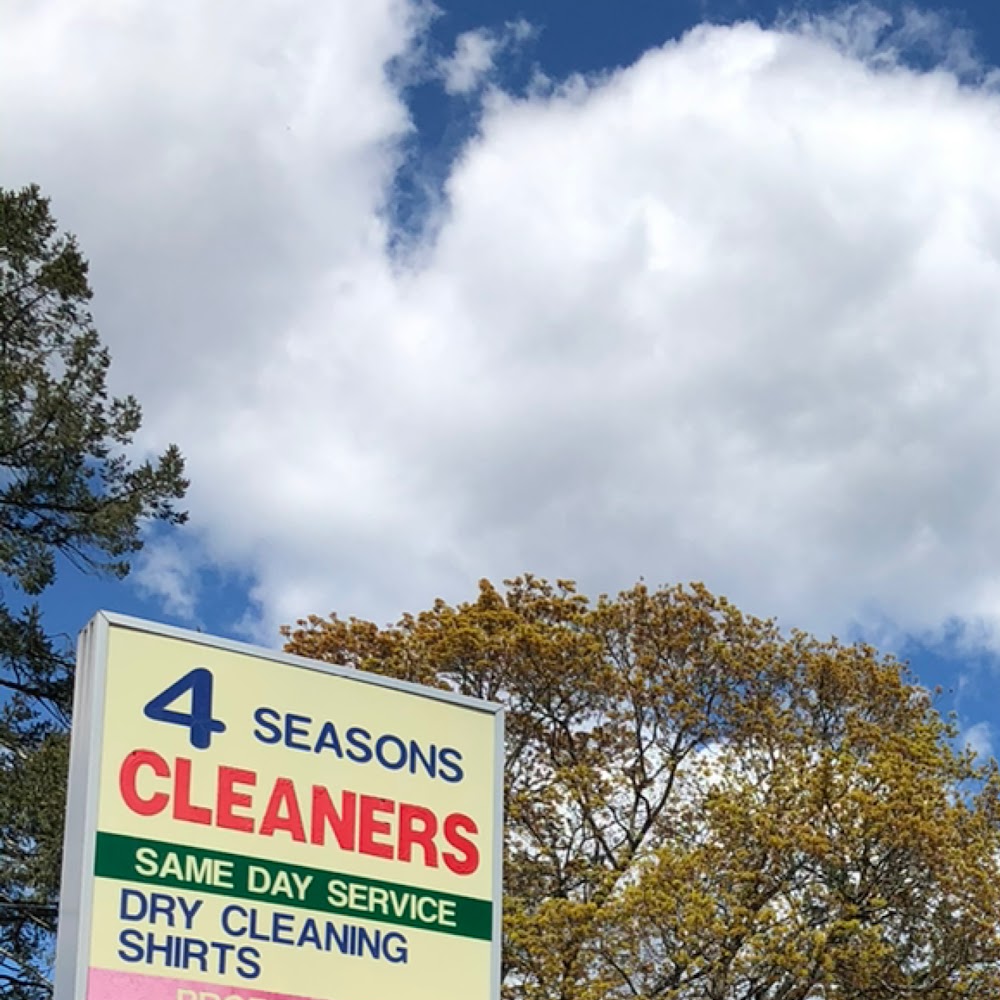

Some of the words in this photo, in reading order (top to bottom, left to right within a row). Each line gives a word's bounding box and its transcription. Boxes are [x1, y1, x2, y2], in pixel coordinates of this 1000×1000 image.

[143, 667, 226, 750] 4
[253, 707, 464, 783] SEASONS
[119, 749, 480, 876] CLEANERS
[120, 889, 202, 929] DRY
[221, 904, 409, 963] CLEANING
[135, 848, 234, 889] SAME
[248, 865, 313, 900] DAY
[327, 880, 457, 927] SERVICE
[118, 929, 261, 979] SHIRTS
